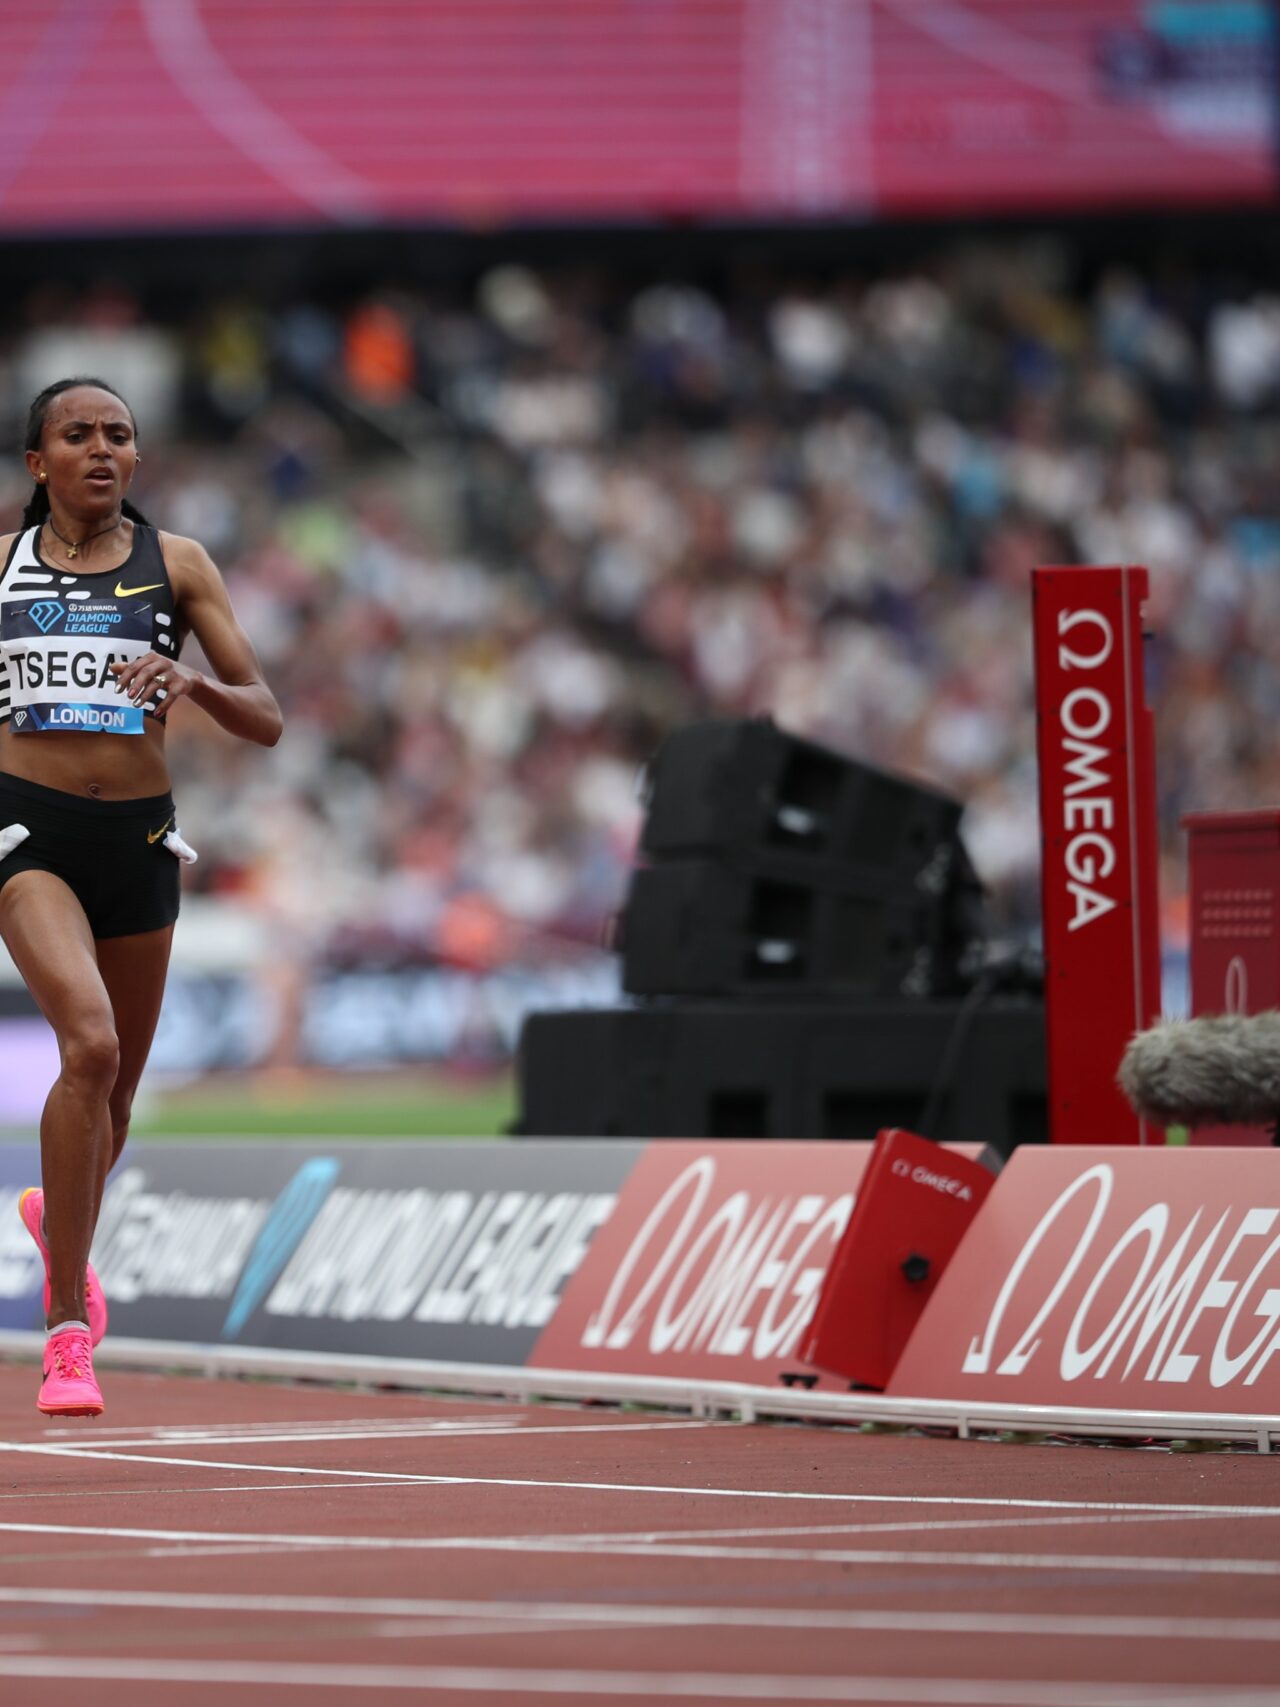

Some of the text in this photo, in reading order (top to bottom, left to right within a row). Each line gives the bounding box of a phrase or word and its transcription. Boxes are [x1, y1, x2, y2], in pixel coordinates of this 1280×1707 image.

[64, 624, 110, 633] LEAGUE
[67, 613, 121, 623] DIAMOND
[9, 651, 142, 690] TSEGA
[49, 708, 125, 728] LONDON
[1059, 687, 1117, 932] OMEGA
[414, 1190, 618, 1329] LEAGUE
[649, 1191, 856, 1360] OMEG
[1060, 1202, 1280, 1388] OMEG
